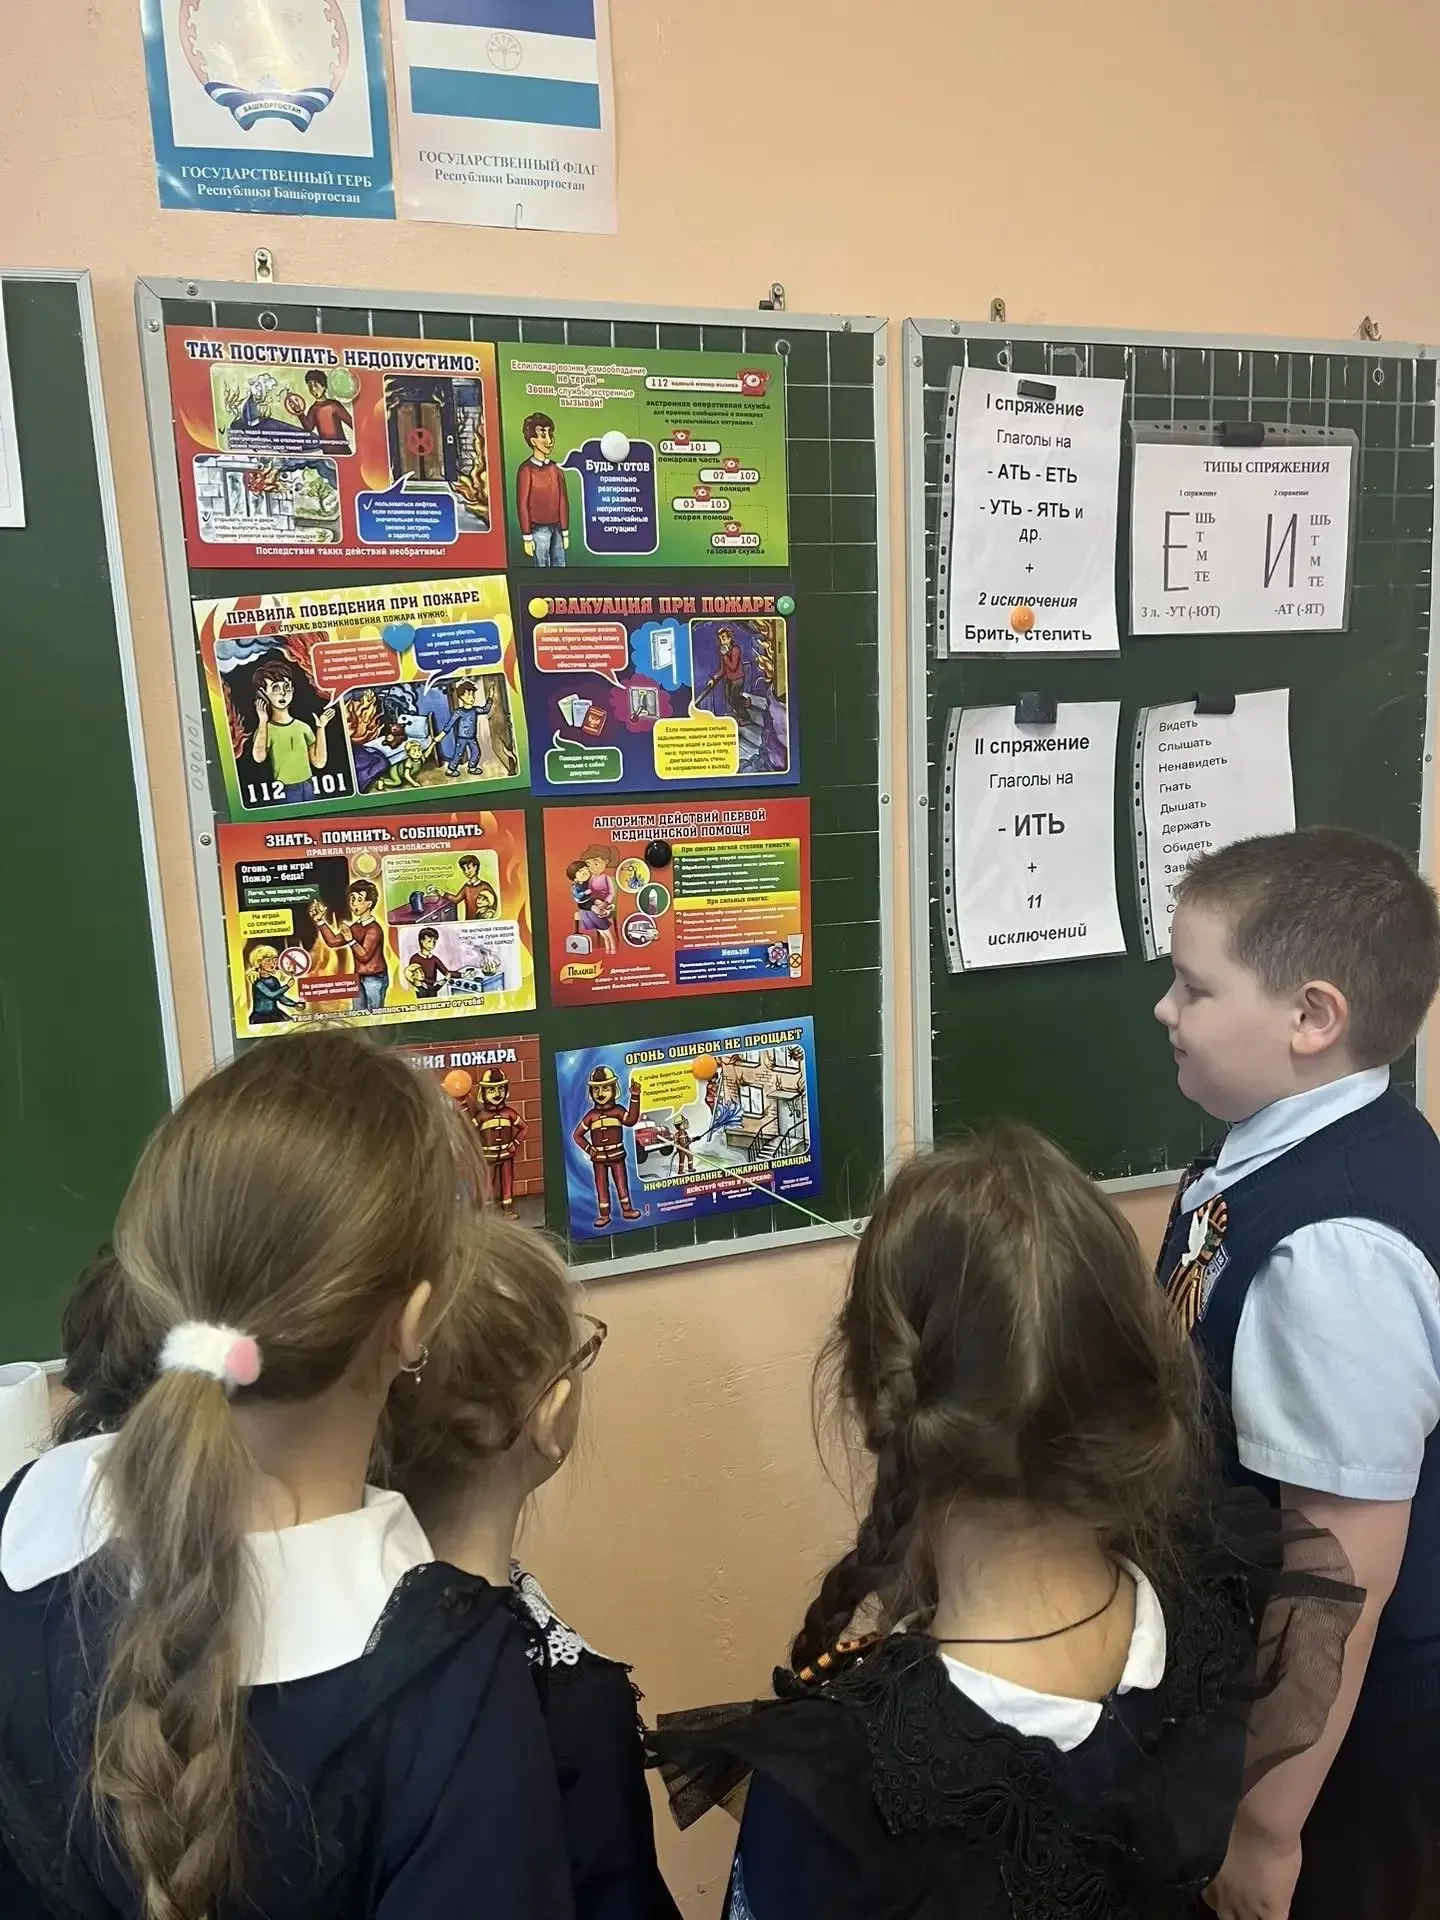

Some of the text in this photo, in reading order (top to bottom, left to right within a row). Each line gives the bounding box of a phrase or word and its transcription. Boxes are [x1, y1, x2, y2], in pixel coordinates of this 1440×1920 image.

[419, 150, 598, 175] ГОСУДАРСТВЕННЫЙ ФЛАГ
[181, 165, 373, 189] ГОСУДАРСТВЕННЫЙ ГЕРБ
[434, 168, 586, 191] Республики Башкортостан
[197, 183, 360, 204] Республики Башкортостан
[185, 341, 480, 371] ТАК ПОСТУПАТЬ НЕДОПУСТИМО:
[511, 360, 532, 370] Если
[533, 363, 556, 373] пожар
[558, 375, 597, 385] не теряй
[651, 378, 668, 387] 112
[560, 398, 603, 407] вызывай!
[995, 396, 1085, 419] спряжение
[996, 428, 1072, 449] Глаголы на
[662, 443, 674, 451] 01
[690, 443, 707, 451] 101
[585, 459, 614, 473] Будь
[997, 464, 1078, 484] АТЬ ЕТЬ
[1204, 460, 1330, 475] ТИПЫ СПРЯЖЕНИЯ
[713, 471, 724, 480] 02
[740, 471, 756, 480] 102
[598, 485, 640, 494] реагировать
[1183, 490, 1217, 498] спряжение
[1278, 490, 1309, 498] спряжение
[611, 496, 637, 504] разные
[683, 500, 695, 509] 03
[711, 500, 727, 509] 103
[990, 499, 1084, 519] УТЬ ЯТЬ и
[1195, 512, 1216, 524] ШЬ
[1310, 514, 1332, 526] ШЬ
[603, 525, 638, 534] ситуации!
[1019, 527, 1043, 544] др.
[1196, 531, 1205, 543] Т
[714, 535, 757, 545] 04 104
[1310, 535, 1320, 546] Т
[255, 545, 446, 557] Последствия таких действий необратимы!
[1163, 511, 1190, 592] Е
[1196, 550, 1208, 562] М
[1263, 513, 1298, 588] И
[1309, 556, 1321, 567] М
[1194, 571, 1211, 582] ТЕ
[1308, 576, 1324, 587] ТЕ
[227, 590, 480, 625] ПРАВИЛА ПОВЕДЕНИЯ ПРИ ПОЖАРЕ
[658, 597, 696, 614] ПРИ
[701, 595, 775, 613] ПОЖАРЕ
[978, 592, 1079, 609] 2 исключения
[1149, 609, 1160, 618] л.
[1165, 605, 1187, 618] -УТ
[1188, 604, 1221, 620] (-ЮТ)
[1274, 602, 1325, 617] -АТ (-ЯТ)
[278, 622, 310, 633] СЛУЧАЕ
[312, 615, 381, 630] ВОЗНИКНОВЕНИЯ
[383, 613, 416, 624] ПОЖАРА
[417, 610, 448, 621] НУЖНО:
[965, 624, 1093, 644] Брить, стелить
[1159, 719, 1198, 732] Видеть
[989, 737, 1090, 757] спряжение
[1158, 738, 1212, 752] Слышать
[1158, 756, 1228, 773] Ненавидеть
[247, 772, 347, 803] 112 101
[989, 772, 1074, 791] Глаголы на
[1159, 782, 1192, 794] Гнать
[1160, 800, 1207, 816] Дышать
[594, 809, 766, 828] АЛГОРИТМ ДЕЙСТВИЙ ПЕРВОЙ
[1014, 813, 1066, 838] ИТЬ
[399, 823, 483, 841] СОБЛЮДАТЬ
[611, 823, 750, 841] МЕДИЦИНСКОЙ ПОМОЩИ
[1161, 820, 1212, 836] Держать
[306, 848, 344, 857] ПРАВИЛА
[391, 841, 451, 853] БЕЗОПАСНОСТИ
[1162, 839, 1213, 854] Обидеть
[241, 861, 314, 874] Огонь не игра!
[1164, 862, 1191, 875] Зав
[242, 872, 304, 884] Пожар беда!
[1027, 893, 1043, 910] 11
[987, 922, 1088, 947] исключений
[417, 1000, 451, 1012] зависит
[451, 999, 462, 1009] от
[625, 1028, 803, 1066] ОГОНЬ ОШИБОК НЕ ПРОЩАЕТ
[450, 1048, 517, 1067] ПОЖАРА
[643, 1170, 723, 1192] ИНФОРМИРОВАНИЕ
[771, 1154, 812, 1169] КОМАНДЫ
